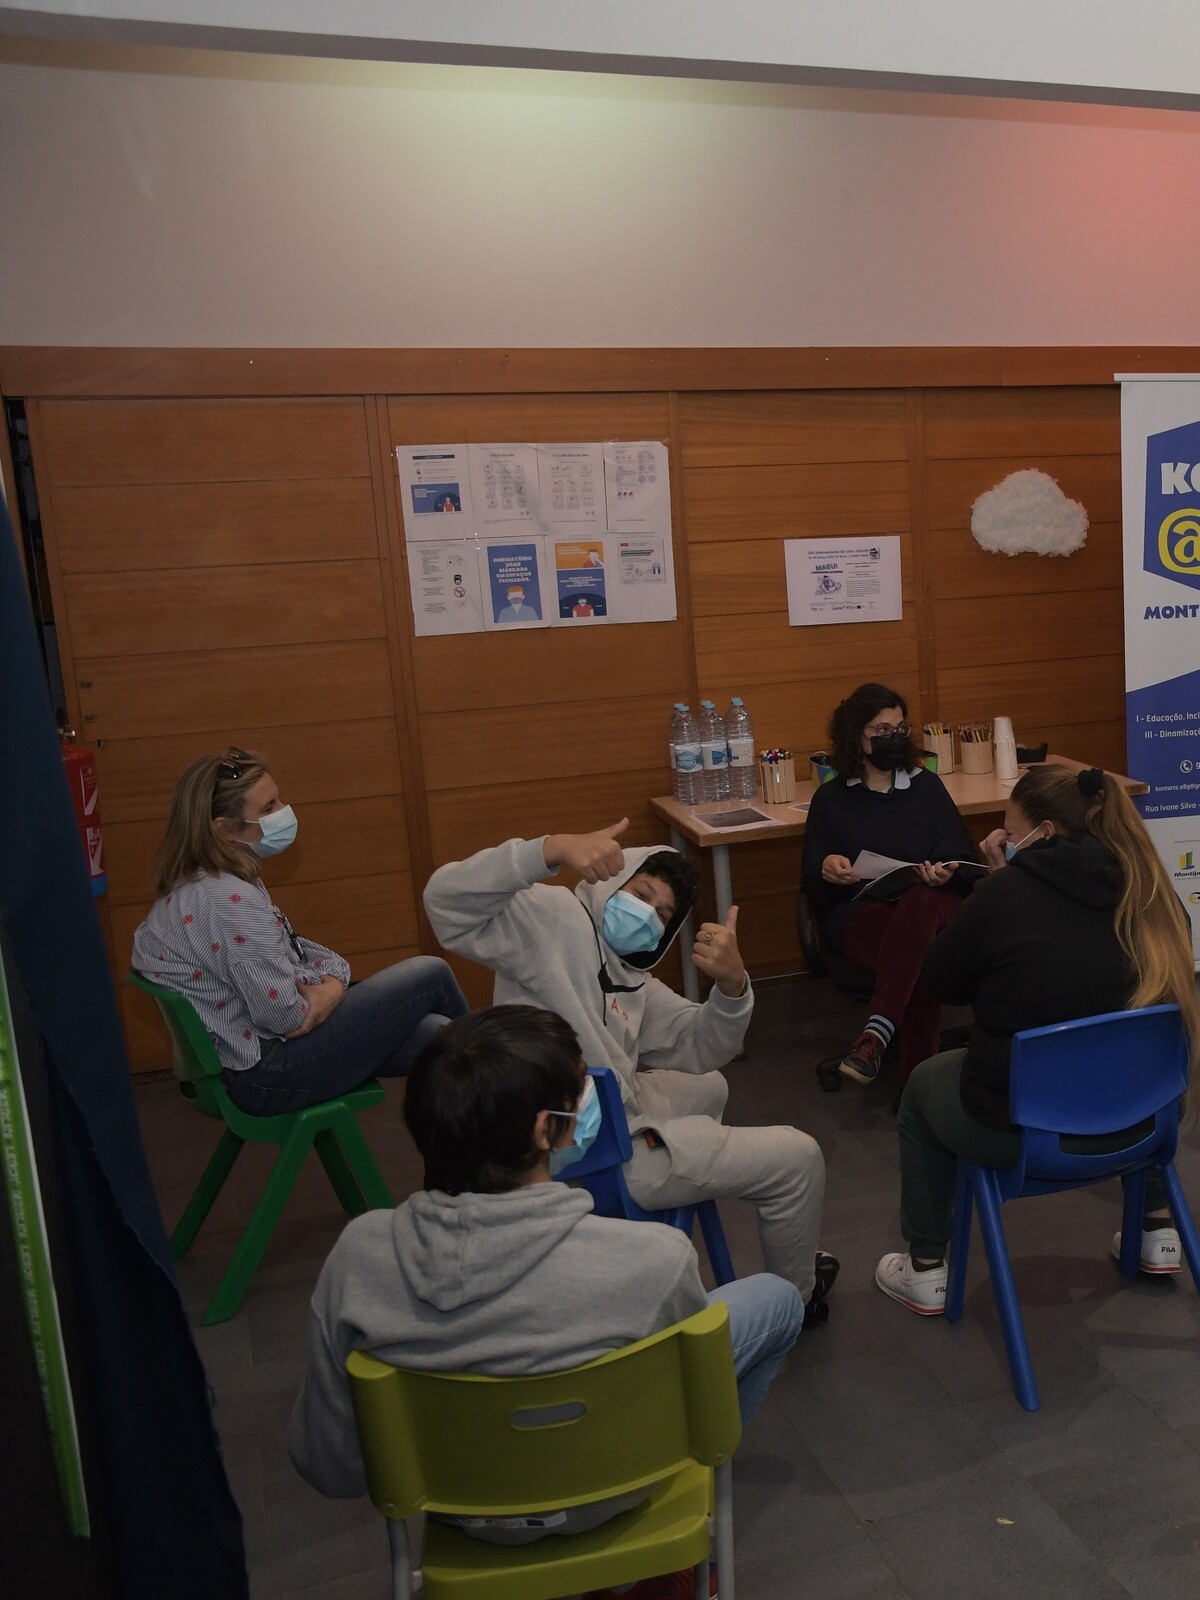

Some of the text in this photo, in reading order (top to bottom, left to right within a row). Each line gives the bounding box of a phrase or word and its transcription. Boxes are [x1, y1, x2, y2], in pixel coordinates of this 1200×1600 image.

[1146, 713, 1185, 723] Educação,
[1144, 731, 1153, 739] III
[1160, 803, 1179, 812] Ivone
[1180, 801, 1197, 810] Silva
[1174, 870, 1200, 878] Montijo
[935, 1285, 947, 1294] FIL
